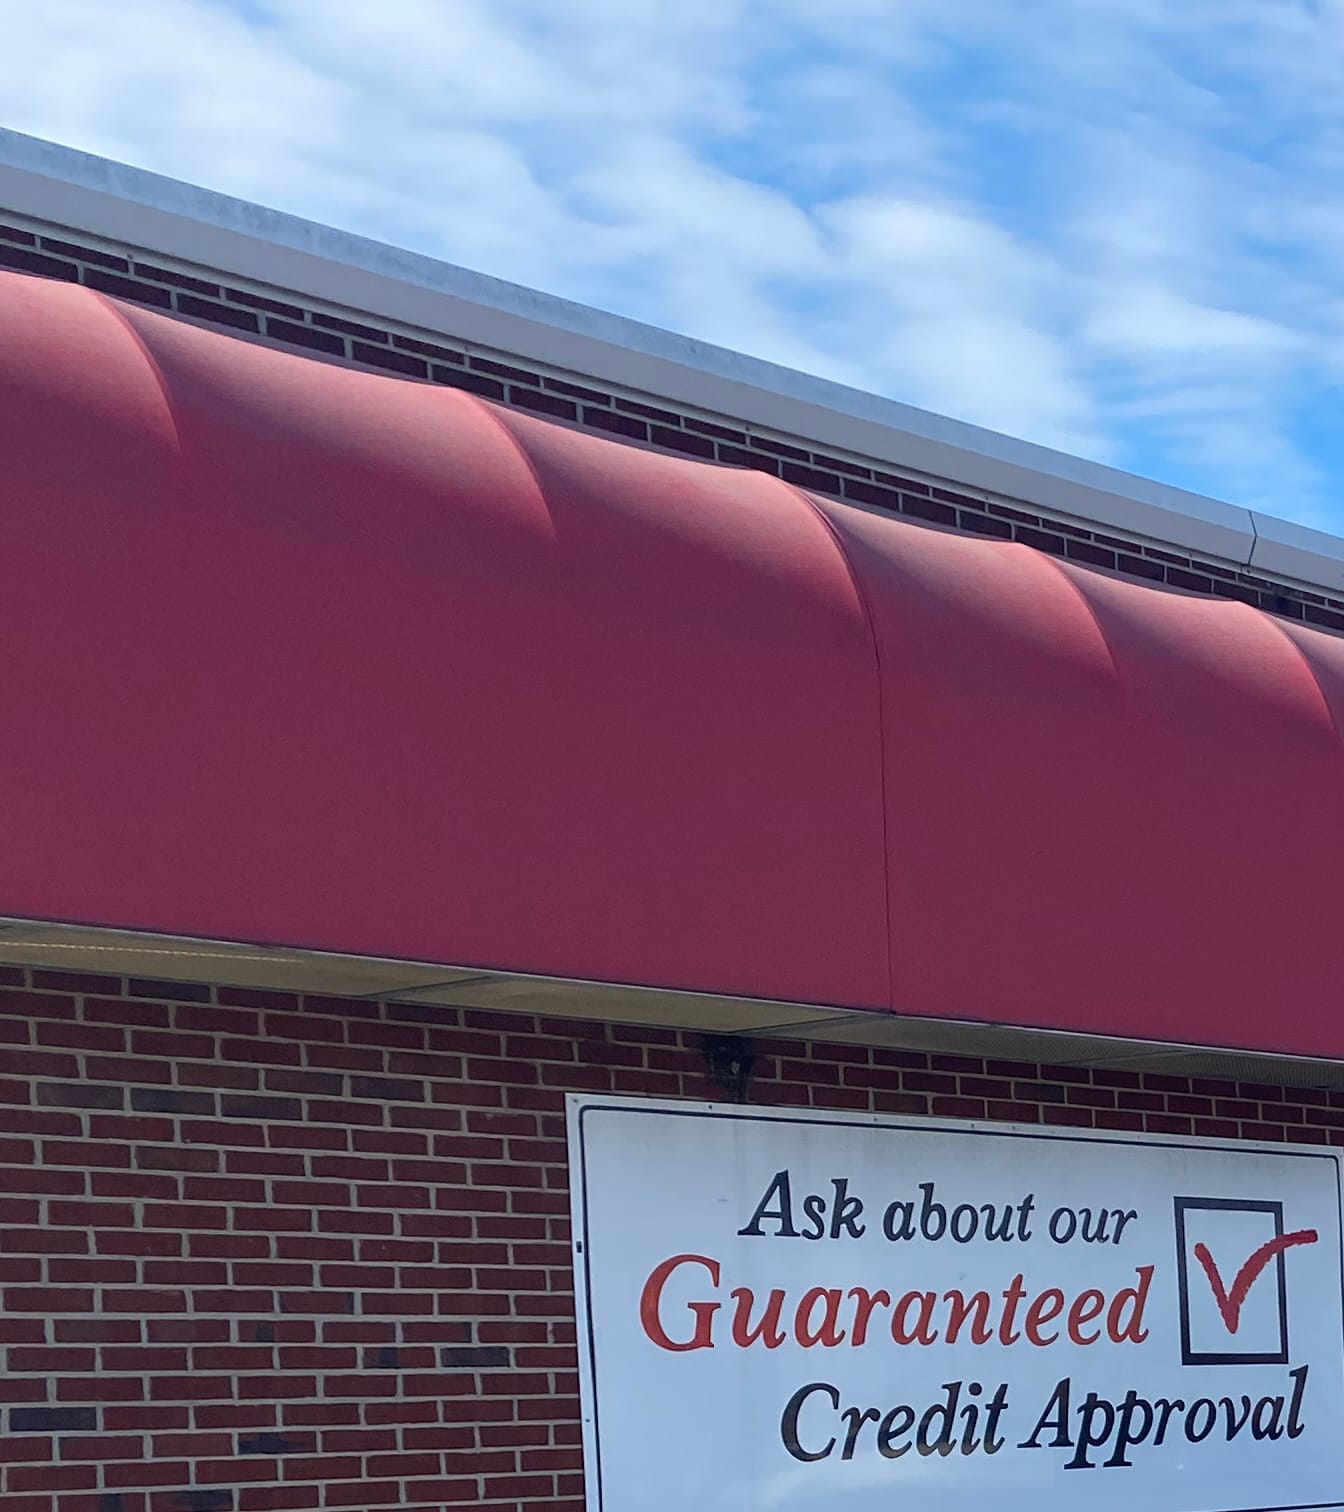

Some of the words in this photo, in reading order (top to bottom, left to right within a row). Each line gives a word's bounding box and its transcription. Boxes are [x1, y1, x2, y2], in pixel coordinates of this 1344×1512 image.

[738, 1170, 866, 1240] Ask
[883, 1183, 1035, 1242] about
[1049, 1207, 1137, 1245] our
[639, 1254, 1154, 1351] Guaranteed
[781, 1382, 1008, 1463] Credit
[1017, 1365, 1309, 1470] Approval
